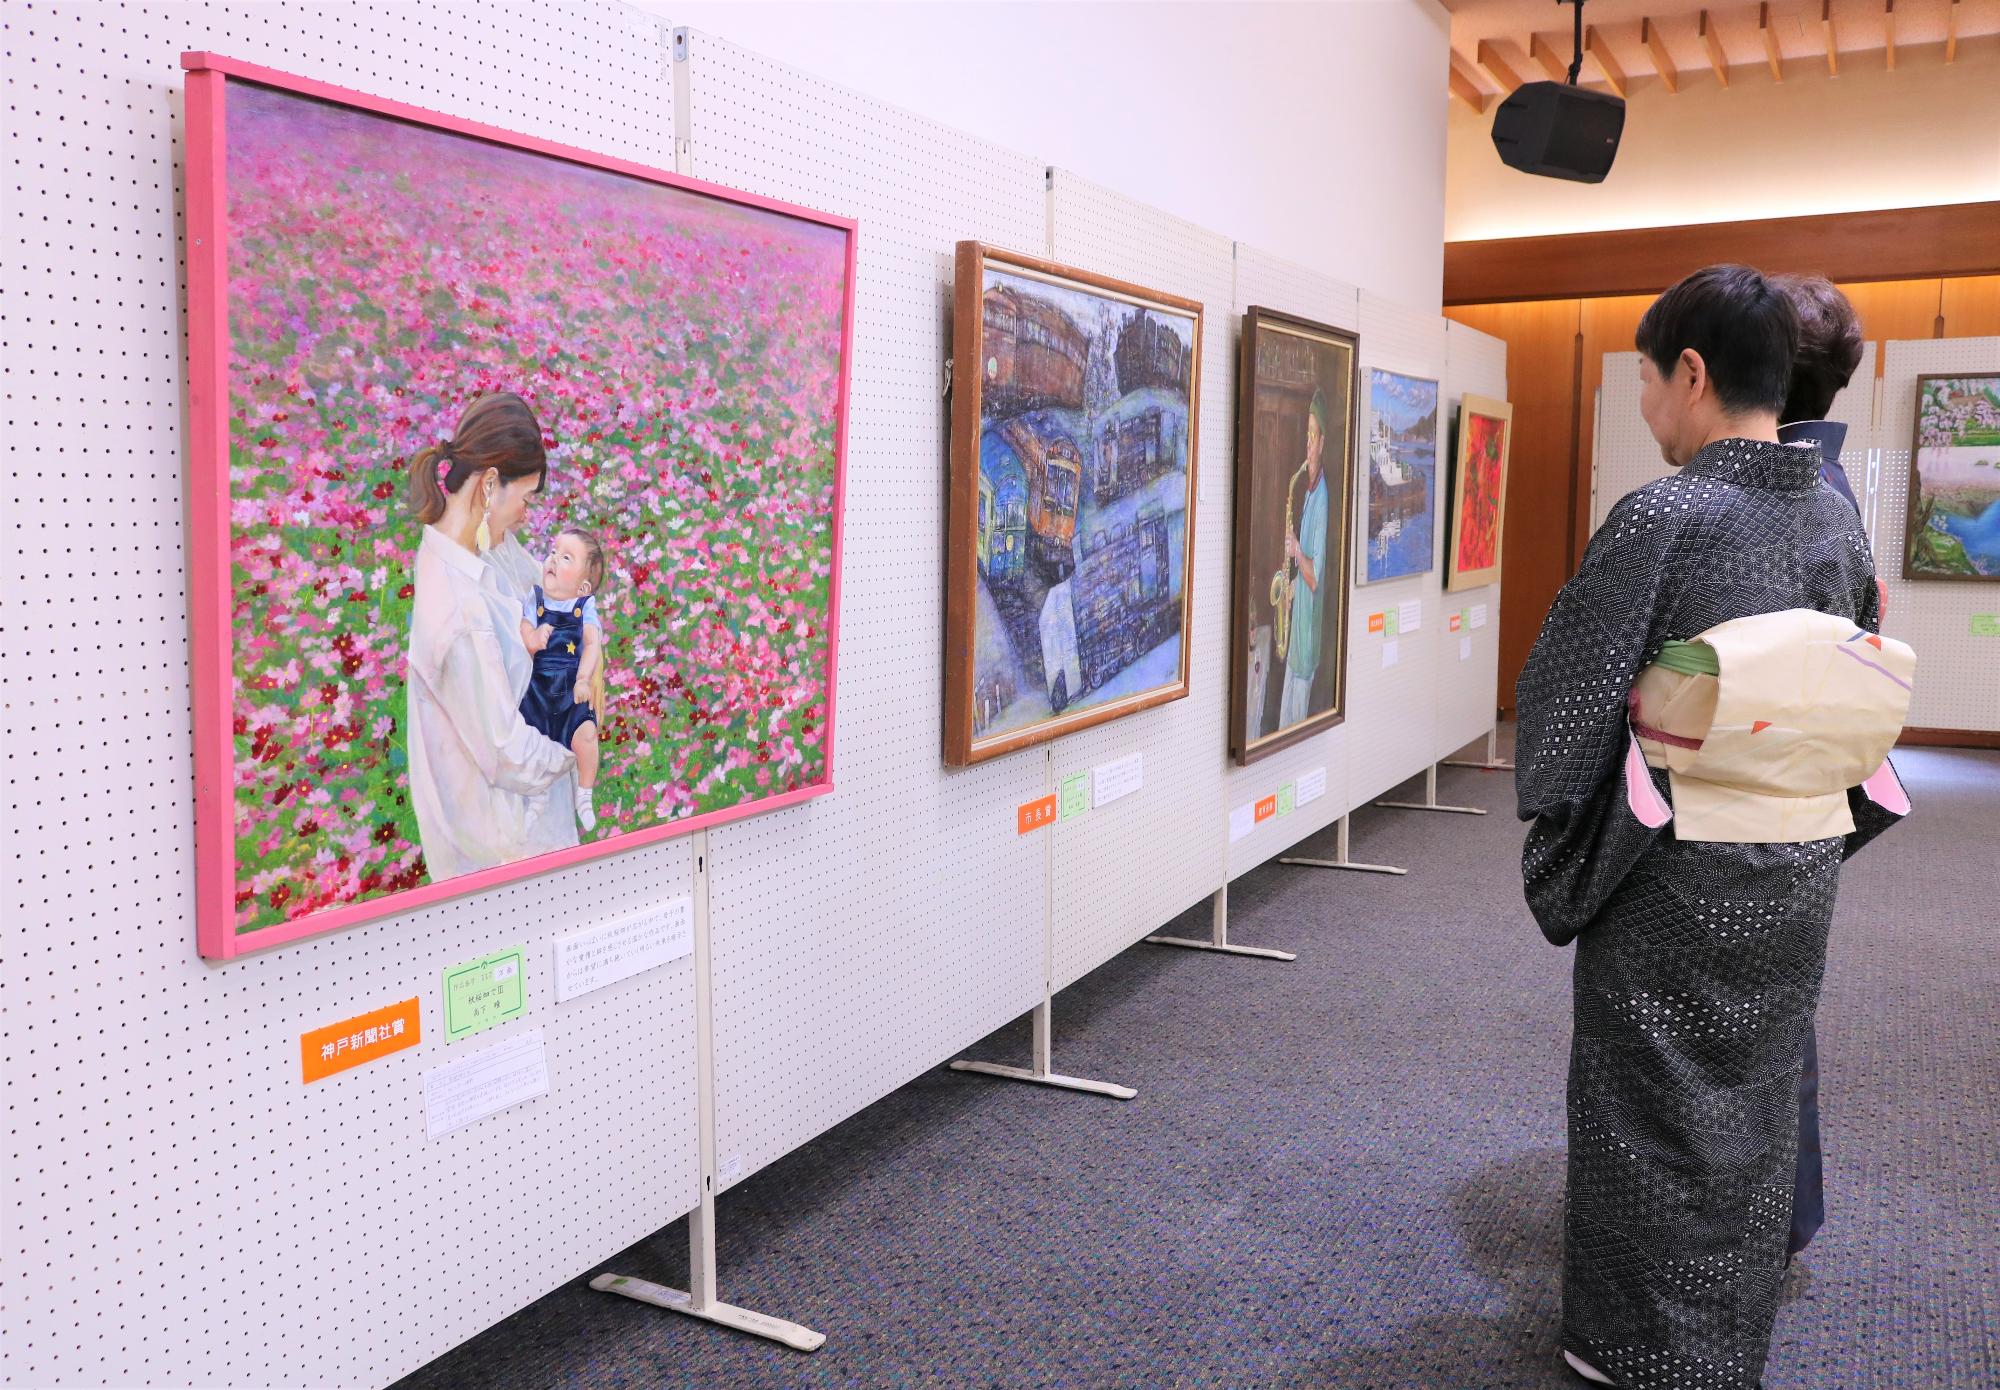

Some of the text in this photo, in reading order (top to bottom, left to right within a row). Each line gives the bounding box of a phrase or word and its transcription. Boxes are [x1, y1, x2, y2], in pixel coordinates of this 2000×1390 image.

[321, 1017, 405, 1062] 神戸新聞社賞
